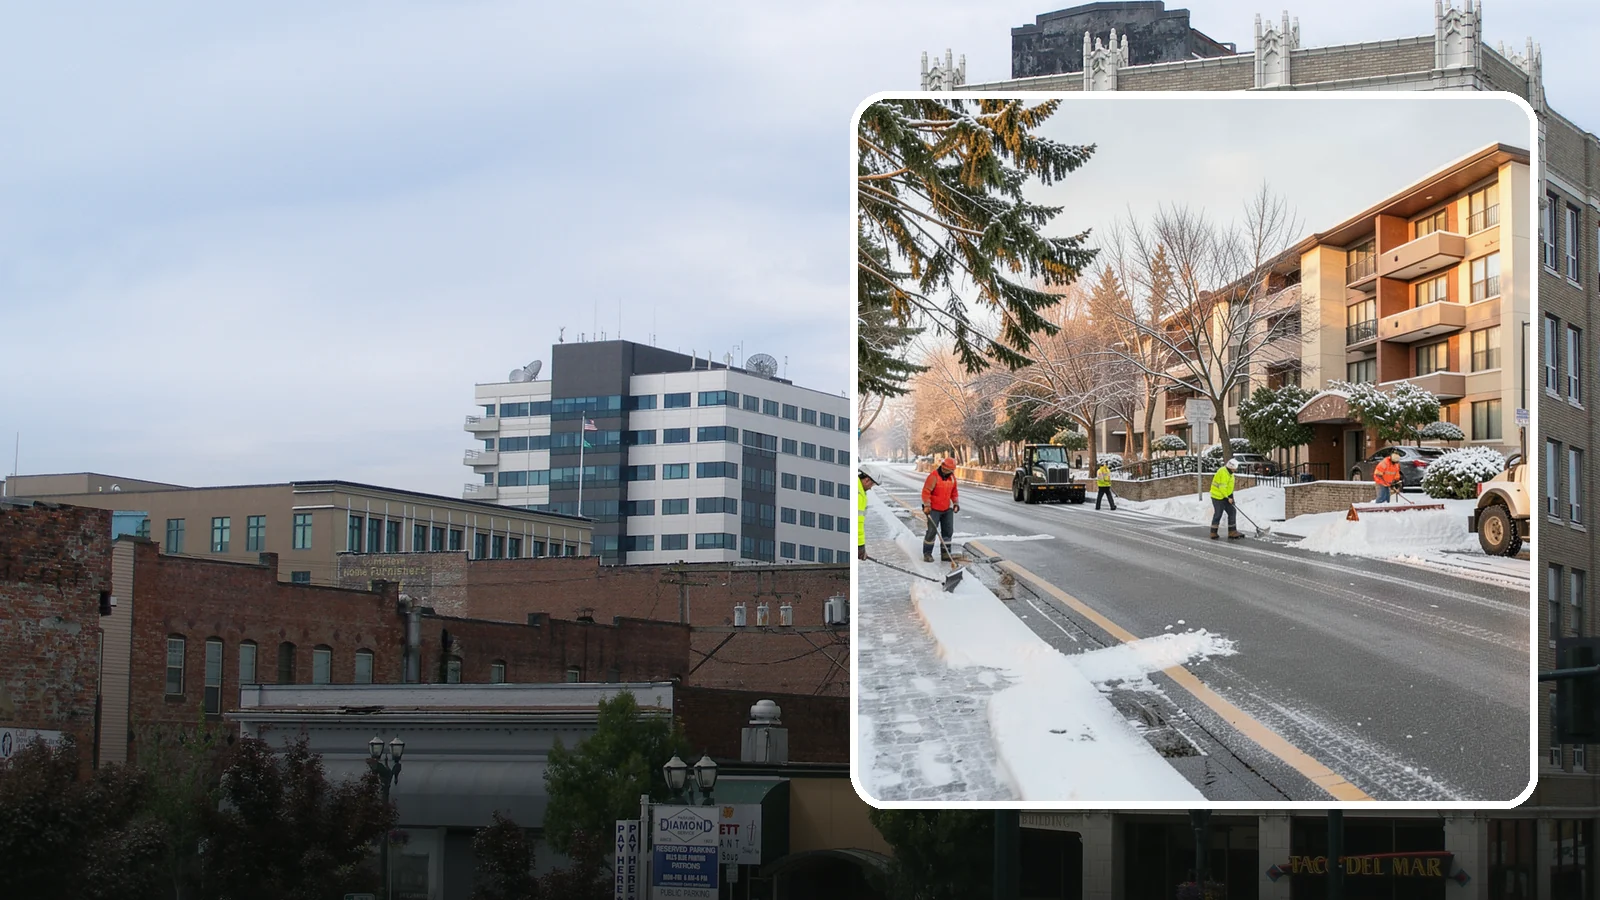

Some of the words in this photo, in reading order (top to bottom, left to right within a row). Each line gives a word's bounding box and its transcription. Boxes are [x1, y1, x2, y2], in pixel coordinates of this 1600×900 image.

[370, 566, 427, 576] Furnishers
[660, 818, 713, 833] DIAMOND
[1022, 815, 1069, 828] BUILDING
[617, 825, 625, 852] PAY
[628, 825, 637, 852] PAY
[656, 845, 688, 853] RESERVED
[689, 846, 716, 854] PARKING
[721, 851, 739, 862] Soup
[671, 862, 701, 870] PATRONS
[1289, 855, 1329, 875] TAC
[1346, 856, 1386, 876] DEL
[1392, 857, 1443, 877] MAR
[616, 856, 625, 894] HERE
[627, 856, 637, 893] HERE
[661, 888, 682, 897] PUBLIC
[684, 889, 710, 898] PARKING
